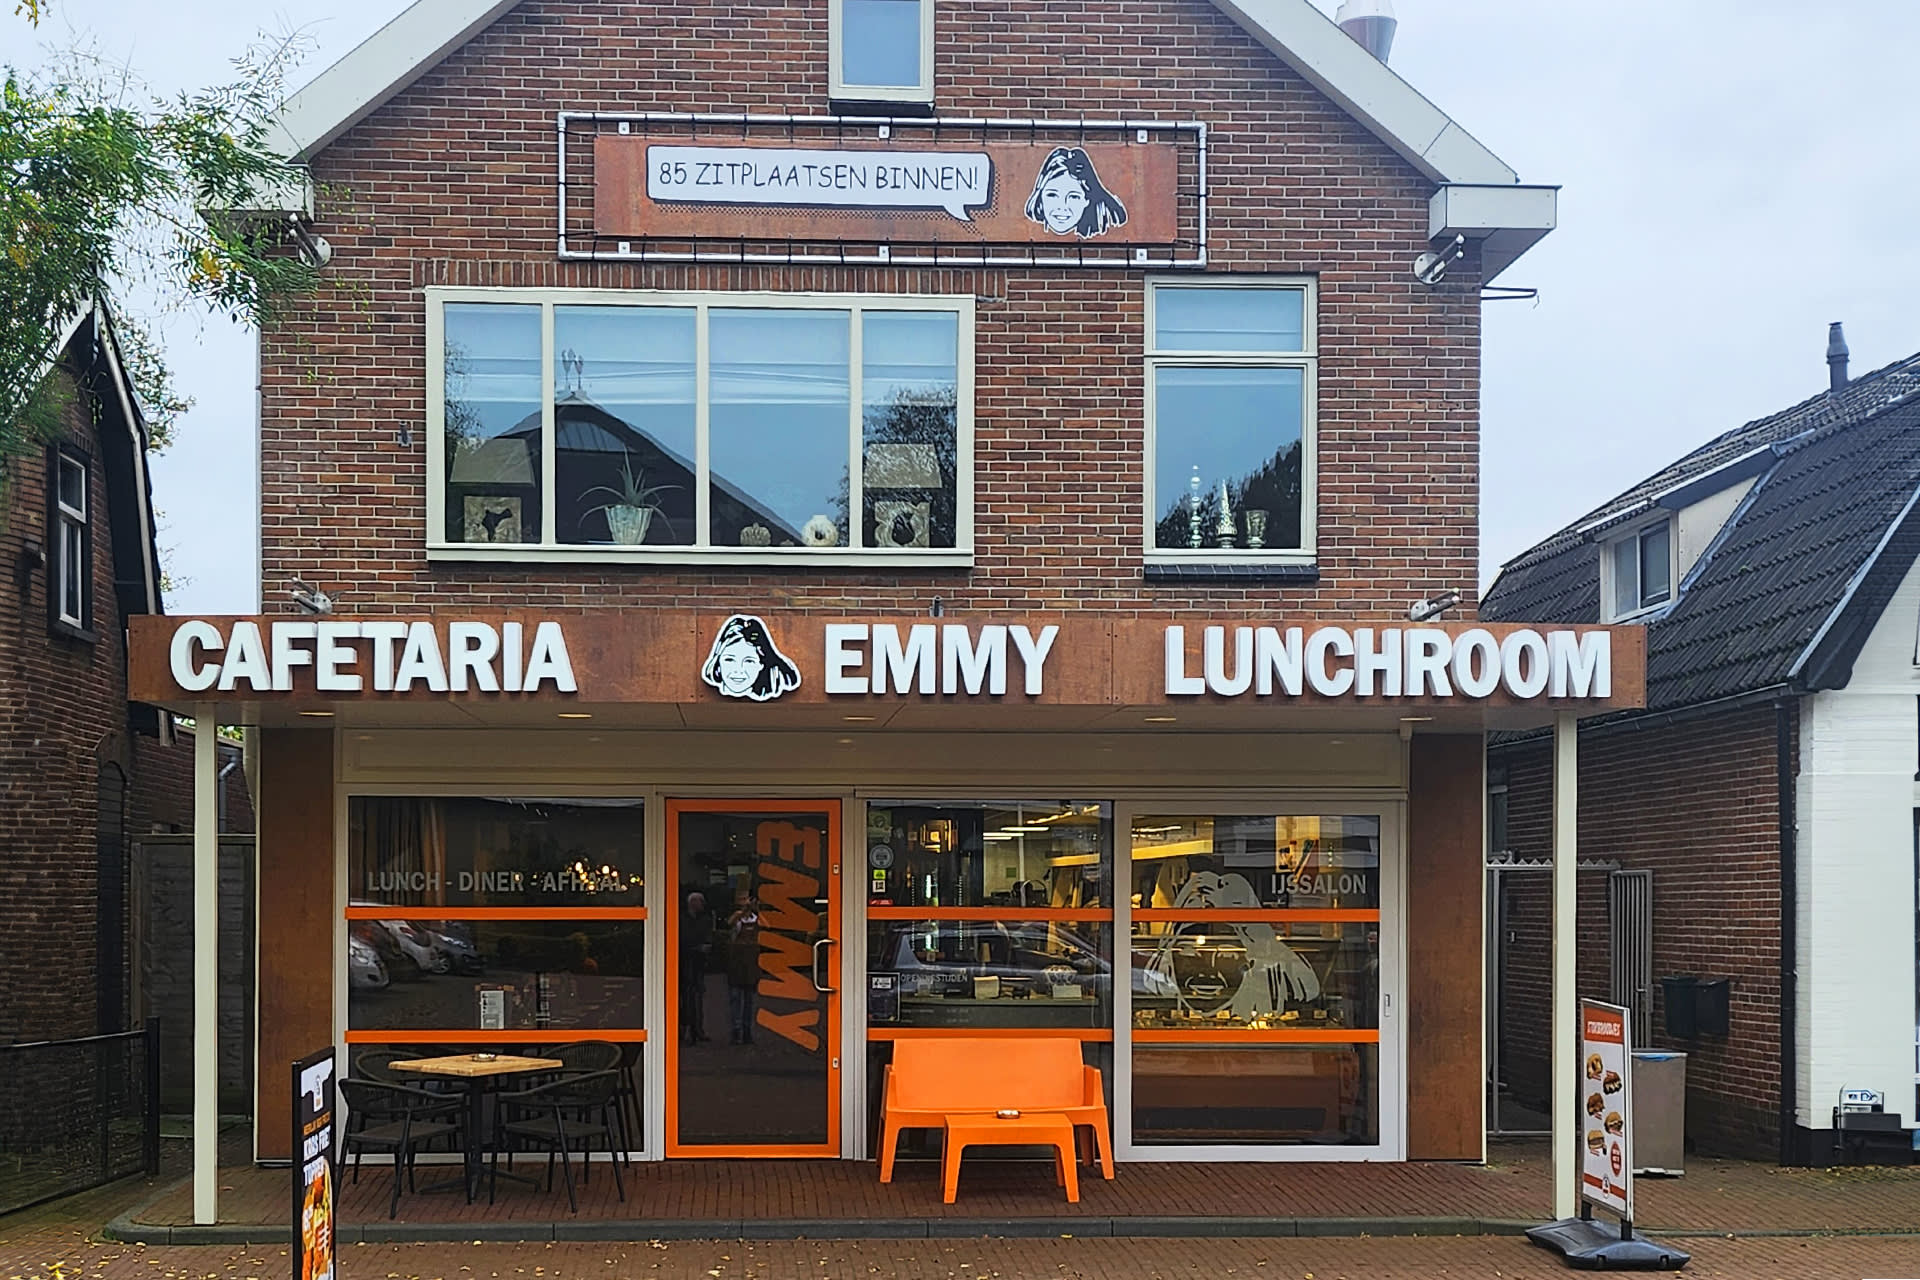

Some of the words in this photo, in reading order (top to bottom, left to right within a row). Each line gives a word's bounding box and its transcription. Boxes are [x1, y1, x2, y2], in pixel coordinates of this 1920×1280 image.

[659, 162, 688, 185] 85
[695, 162, 867, 189] ZITPLAATSEN
[875, 166, 978, 190] BINNEN!
[170, 620, 578, 692] CAFETARIA
[825, 623, 1060, 696] EMMY
[1165, 625, 1612, 698] LUNCHROOM
[368, 871, 441, 892] LUNCH
[459, 871, 524, 892] DINER
[1271, 874, 1367, 895] IJSSALON
[756, 821, 821, 1052] EMMY
